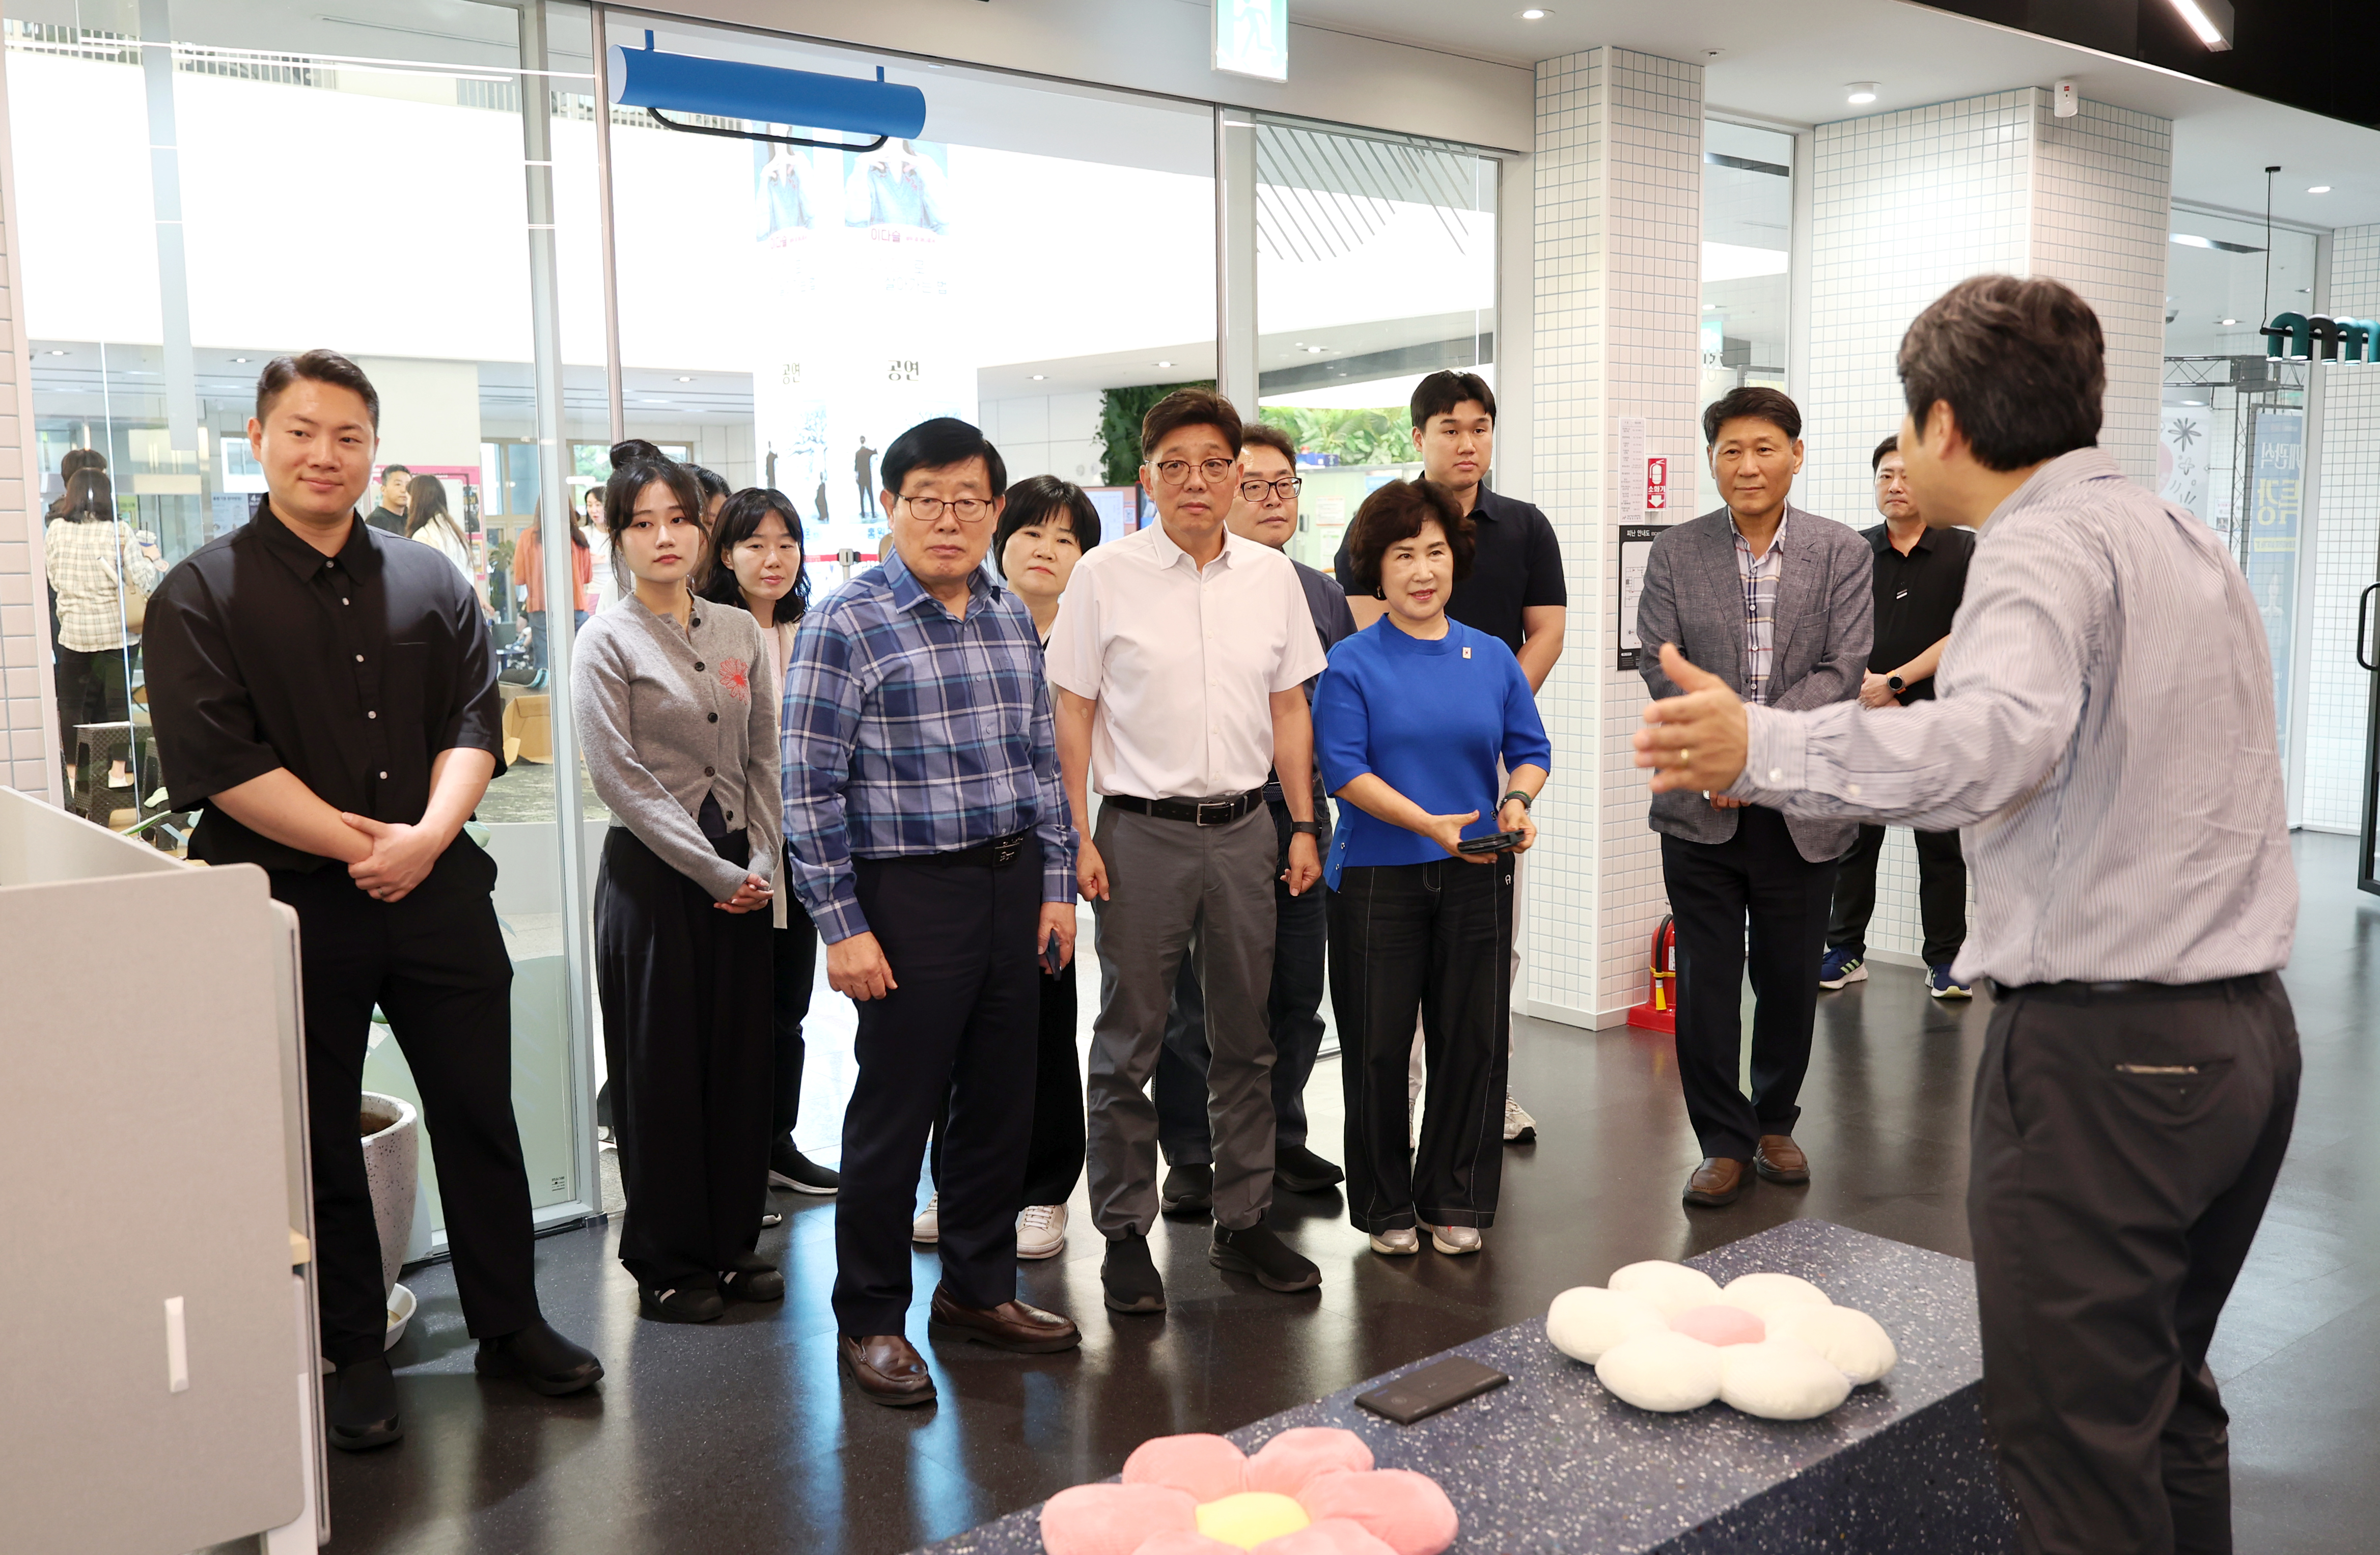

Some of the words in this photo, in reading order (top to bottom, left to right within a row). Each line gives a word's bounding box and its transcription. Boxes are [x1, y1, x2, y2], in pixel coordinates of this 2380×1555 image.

[871, 228, 901, 243] 이다슬
[885, 276, 931, 294] 살아가는
[937, 281, 947, 294] 법
[783, 364, 800, 384] 공연
[888, 360, 919, 380] 공연
